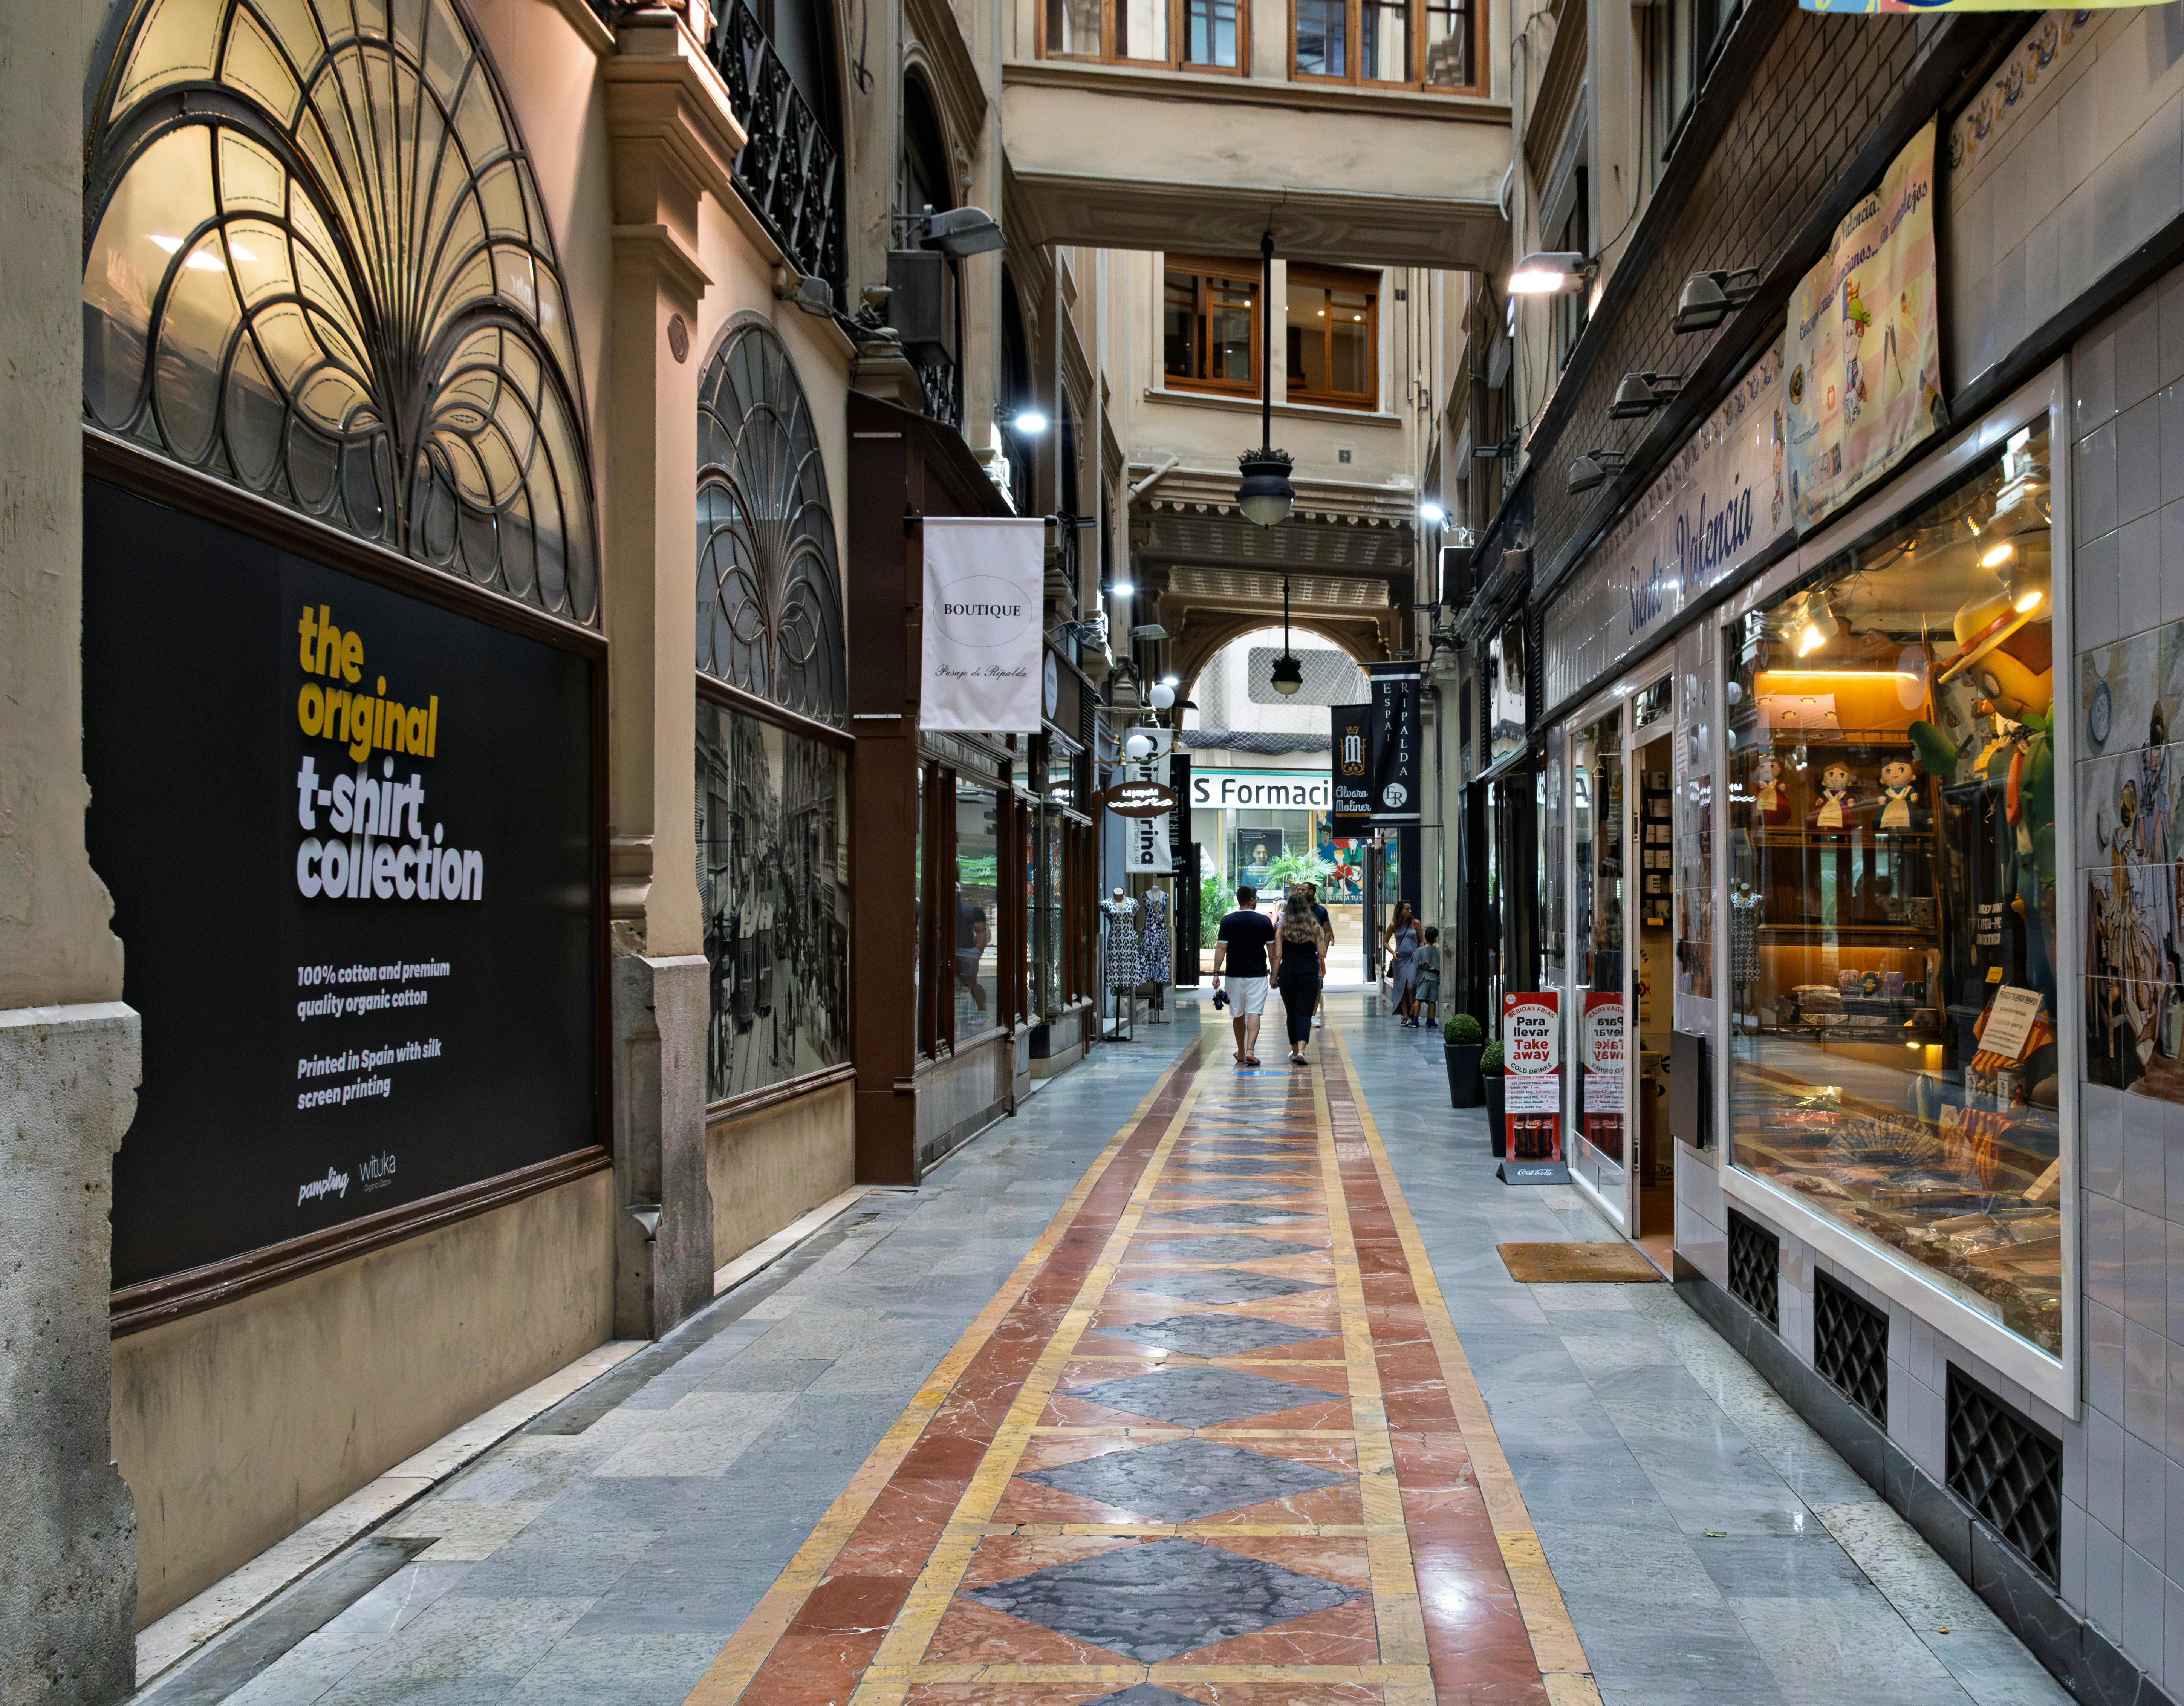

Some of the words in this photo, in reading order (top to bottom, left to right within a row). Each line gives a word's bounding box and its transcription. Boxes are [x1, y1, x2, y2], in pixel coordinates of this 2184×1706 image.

[1677, 472, 1753, 594] Valencia
[944, 604, 1021, 618] BOUTIQUE
[299, 604, 364, 684] the
[935, 664, 968, 679] Pasaje
[971, 666, 980, 676] de
[984, 665, 1027, 680] Ripalda
[298, 676, 439, 762] original
[1383, 683, 1392, 741] ESPAI
[1399, 682, 1409, 776] RIPALDA
[297, 756, 424, 839] t-shirt
[1139, 735, 1158, 864] Chinrina
[1194, 778, 1210, 803] S
[1222, 779, 1328, 805] Formaci
[1335, 800, 1372, 812] Moliner
[1169, 786, 1179, 845] MIRALS
[297, 823, 483, 900] collection
[298, 965, 336, 986] 100%
[338, 962, 377, 983] cotton
[379, 961, 401, 981] and
[402, 958, 450, 983] premium
[297, 993, 345, 1021] quality
[346, 989, 390, 1016] organic
[392, 988, 427, 1007] cotton
[1508, 1006, 1535, 1019] BEBIDAS
[1517, 1016, 1545, 1026] Para
[1513, 1027, 1549, 1037] llevar
[1514, 1039, 1548, 1050] Take
[297, 1054, 346, 1079] Printed
[347, 1049, 360, 1071] in
[361, 1044, 395, 1071] Spain
[396, 1041, 421, 1062] with
[422, 1037, 442, 1058] silk
[1511, 1063, 1527, 1073] COLD
[1529, 1063, 1552, 1074] DRINKS
[1513, 1051, 1550, 1062] away
[297, 1085, 341, 1109] screen
[342, 1074, 391, 1105] printing
[298, 1166, 349, 1206] pampling
[359, 1150, 395, 1181] wituka
